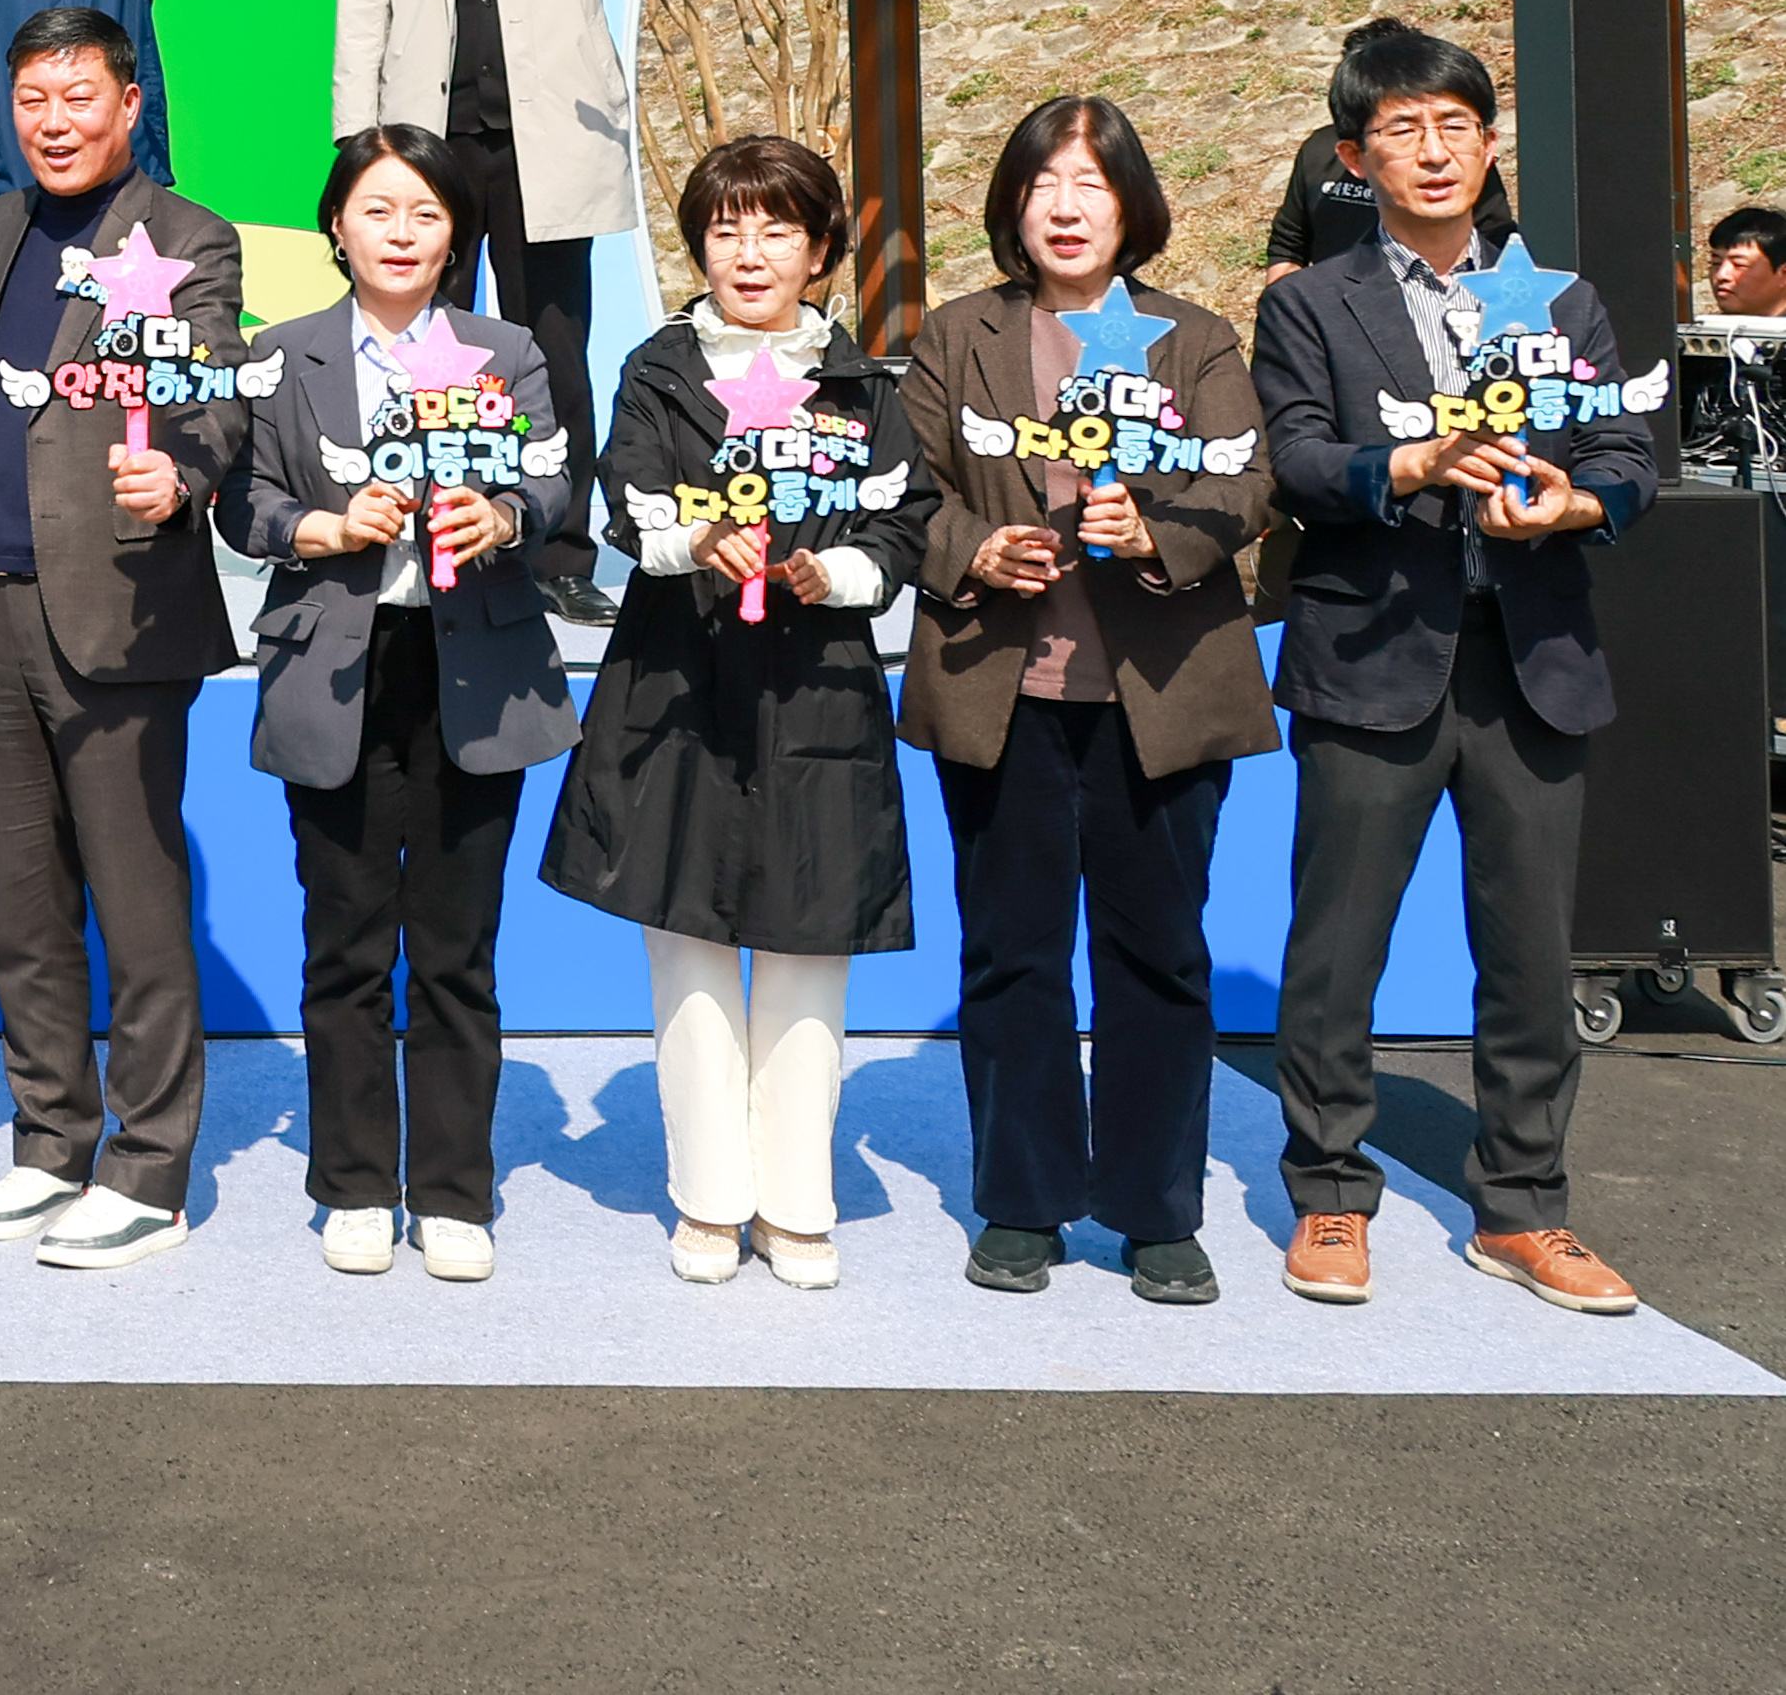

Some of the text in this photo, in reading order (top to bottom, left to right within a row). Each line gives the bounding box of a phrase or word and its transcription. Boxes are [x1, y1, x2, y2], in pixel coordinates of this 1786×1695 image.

[142, 315, 191, 357] 더
[1517, 331, 1571, 376] 더
[53, 359, 234, 410] 안전하게
[1109, 375, 1162, 419] 더
[1429, 377, 1621, 437] 자유롭게
[415, 387, 514, 429] 모두의
[815, 412, 866, 439] 모두의
[372, 429, 522, 487] 이동권
[761, 428, 811, 469] 더
[1013, 415, 1203, 474] 자유롭게
[674, 471, 857, 526] 자유롭게
